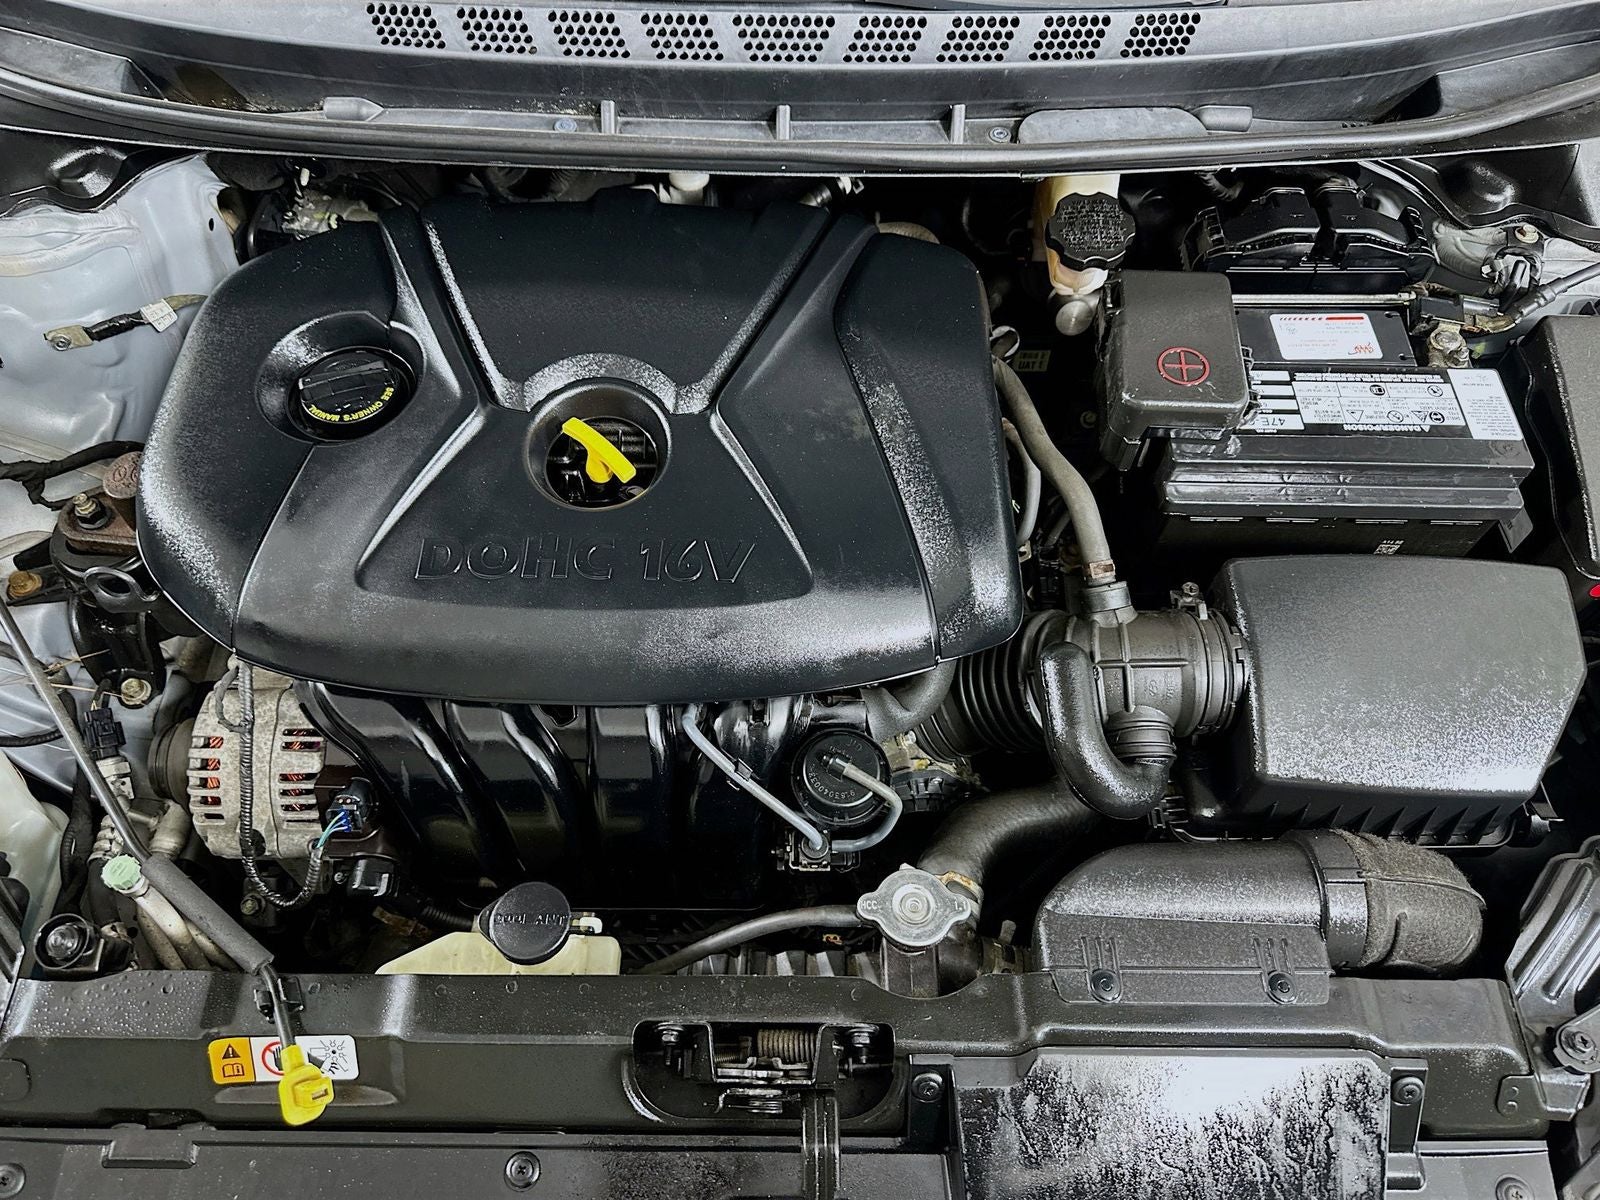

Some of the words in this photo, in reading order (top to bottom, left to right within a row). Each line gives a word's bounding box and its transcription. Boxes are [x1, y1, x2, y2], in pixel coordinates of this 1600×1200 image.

[380, 387, 395, 401] SEE
[308, 403, 341, 422] MANUAL
[342, 400, 384, 422] OWNER'S
[414, 537, 616, 581] DOHC
[639, 538, 757, 584] 16V
